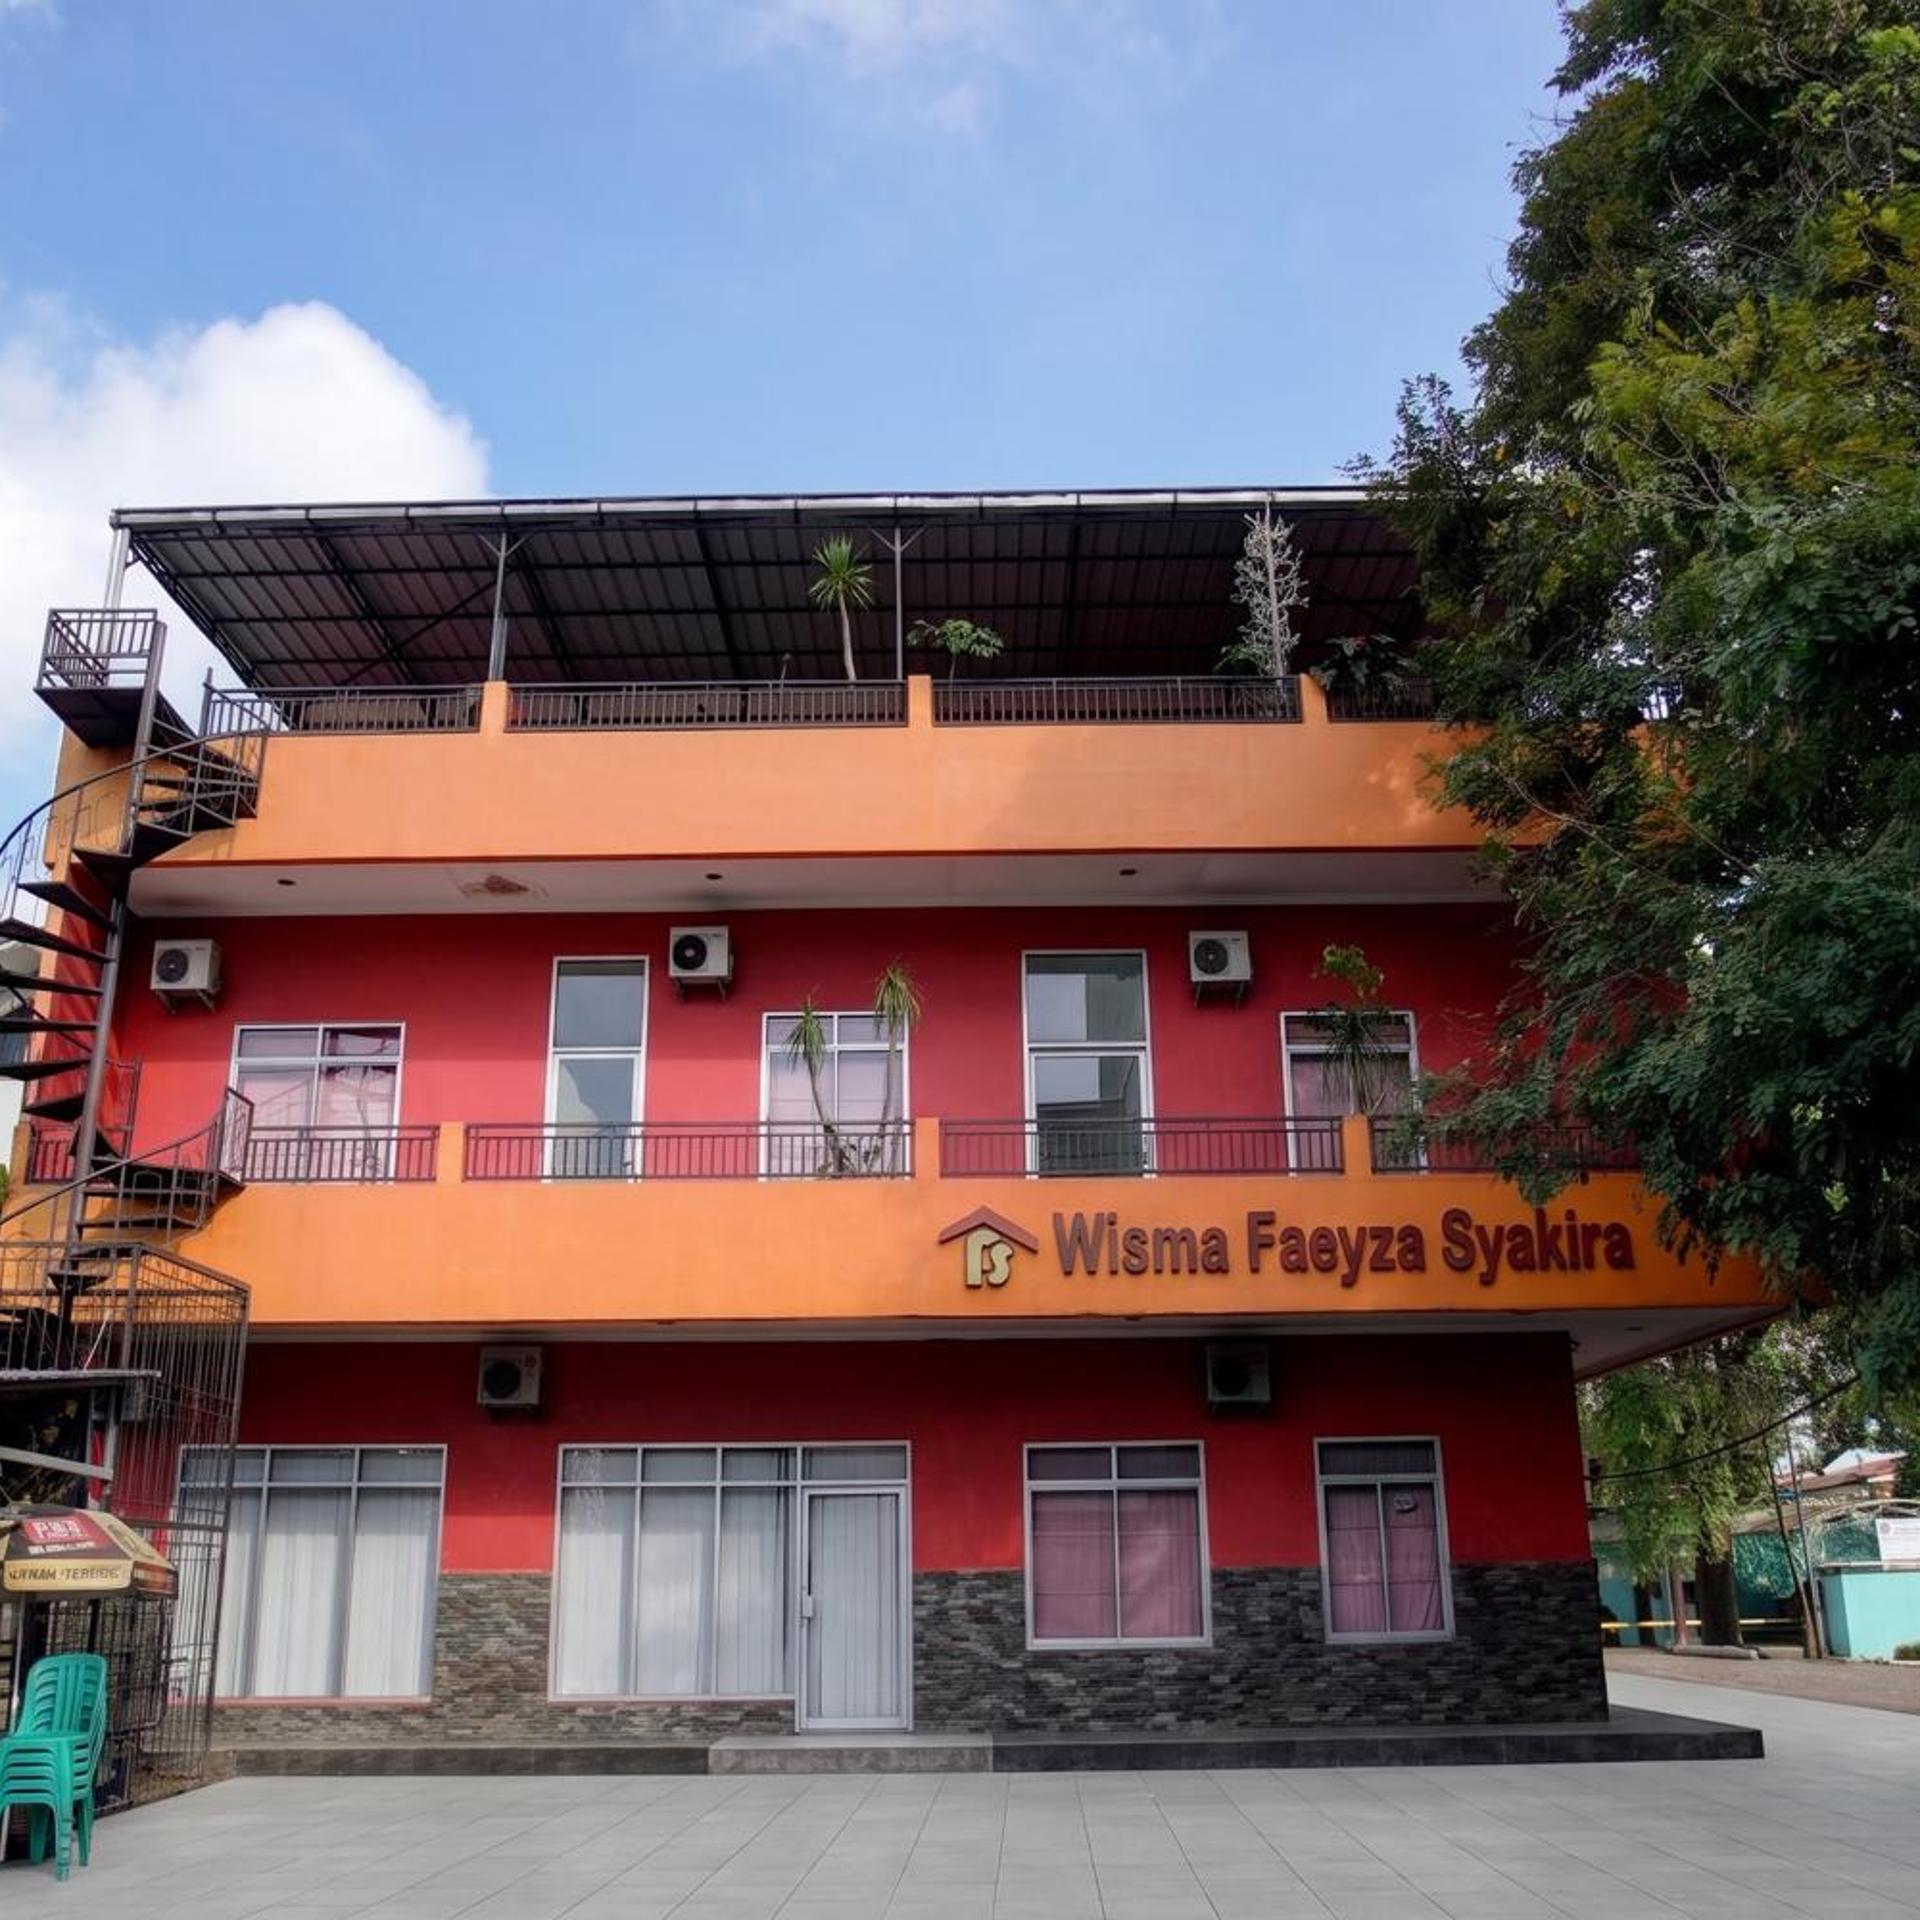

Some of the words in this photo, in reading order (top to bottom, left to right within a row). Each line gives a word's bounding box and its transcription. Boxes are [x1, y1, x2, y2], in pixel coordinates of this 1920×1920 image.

[1052, 1211, 1229, 1275] Wisma
[1246, 1210, 1426, 1288] Faeyza
[1440, 1207, 1636, 1287] Syakira
